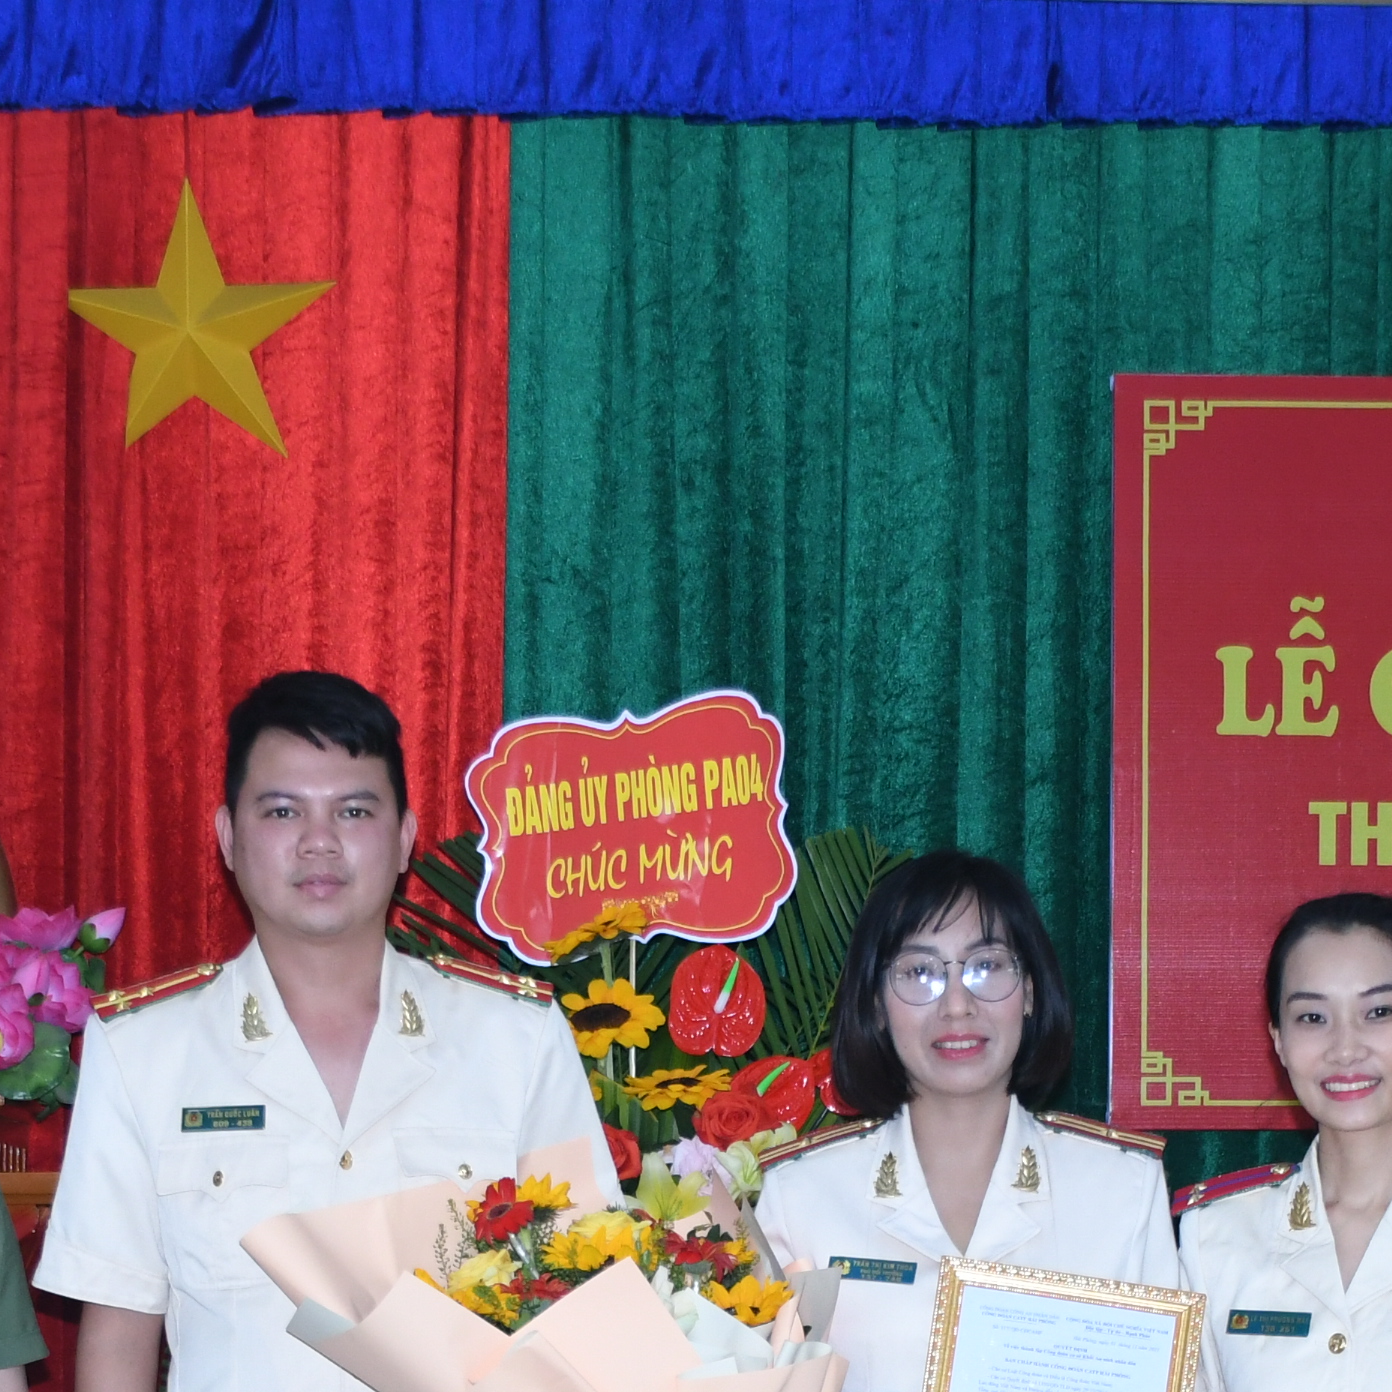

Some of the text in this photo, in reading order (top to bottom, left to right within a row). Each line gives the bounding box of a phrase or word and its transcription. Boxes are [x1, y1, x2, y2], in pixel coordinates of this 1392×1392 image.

[1215, 596, 1339, 737] LỄ
[505, 753, 764, 837] ĐẢNG ỦY PHÒNG PA04
[546, 828, 734, 899] CHÚC MỪNG
